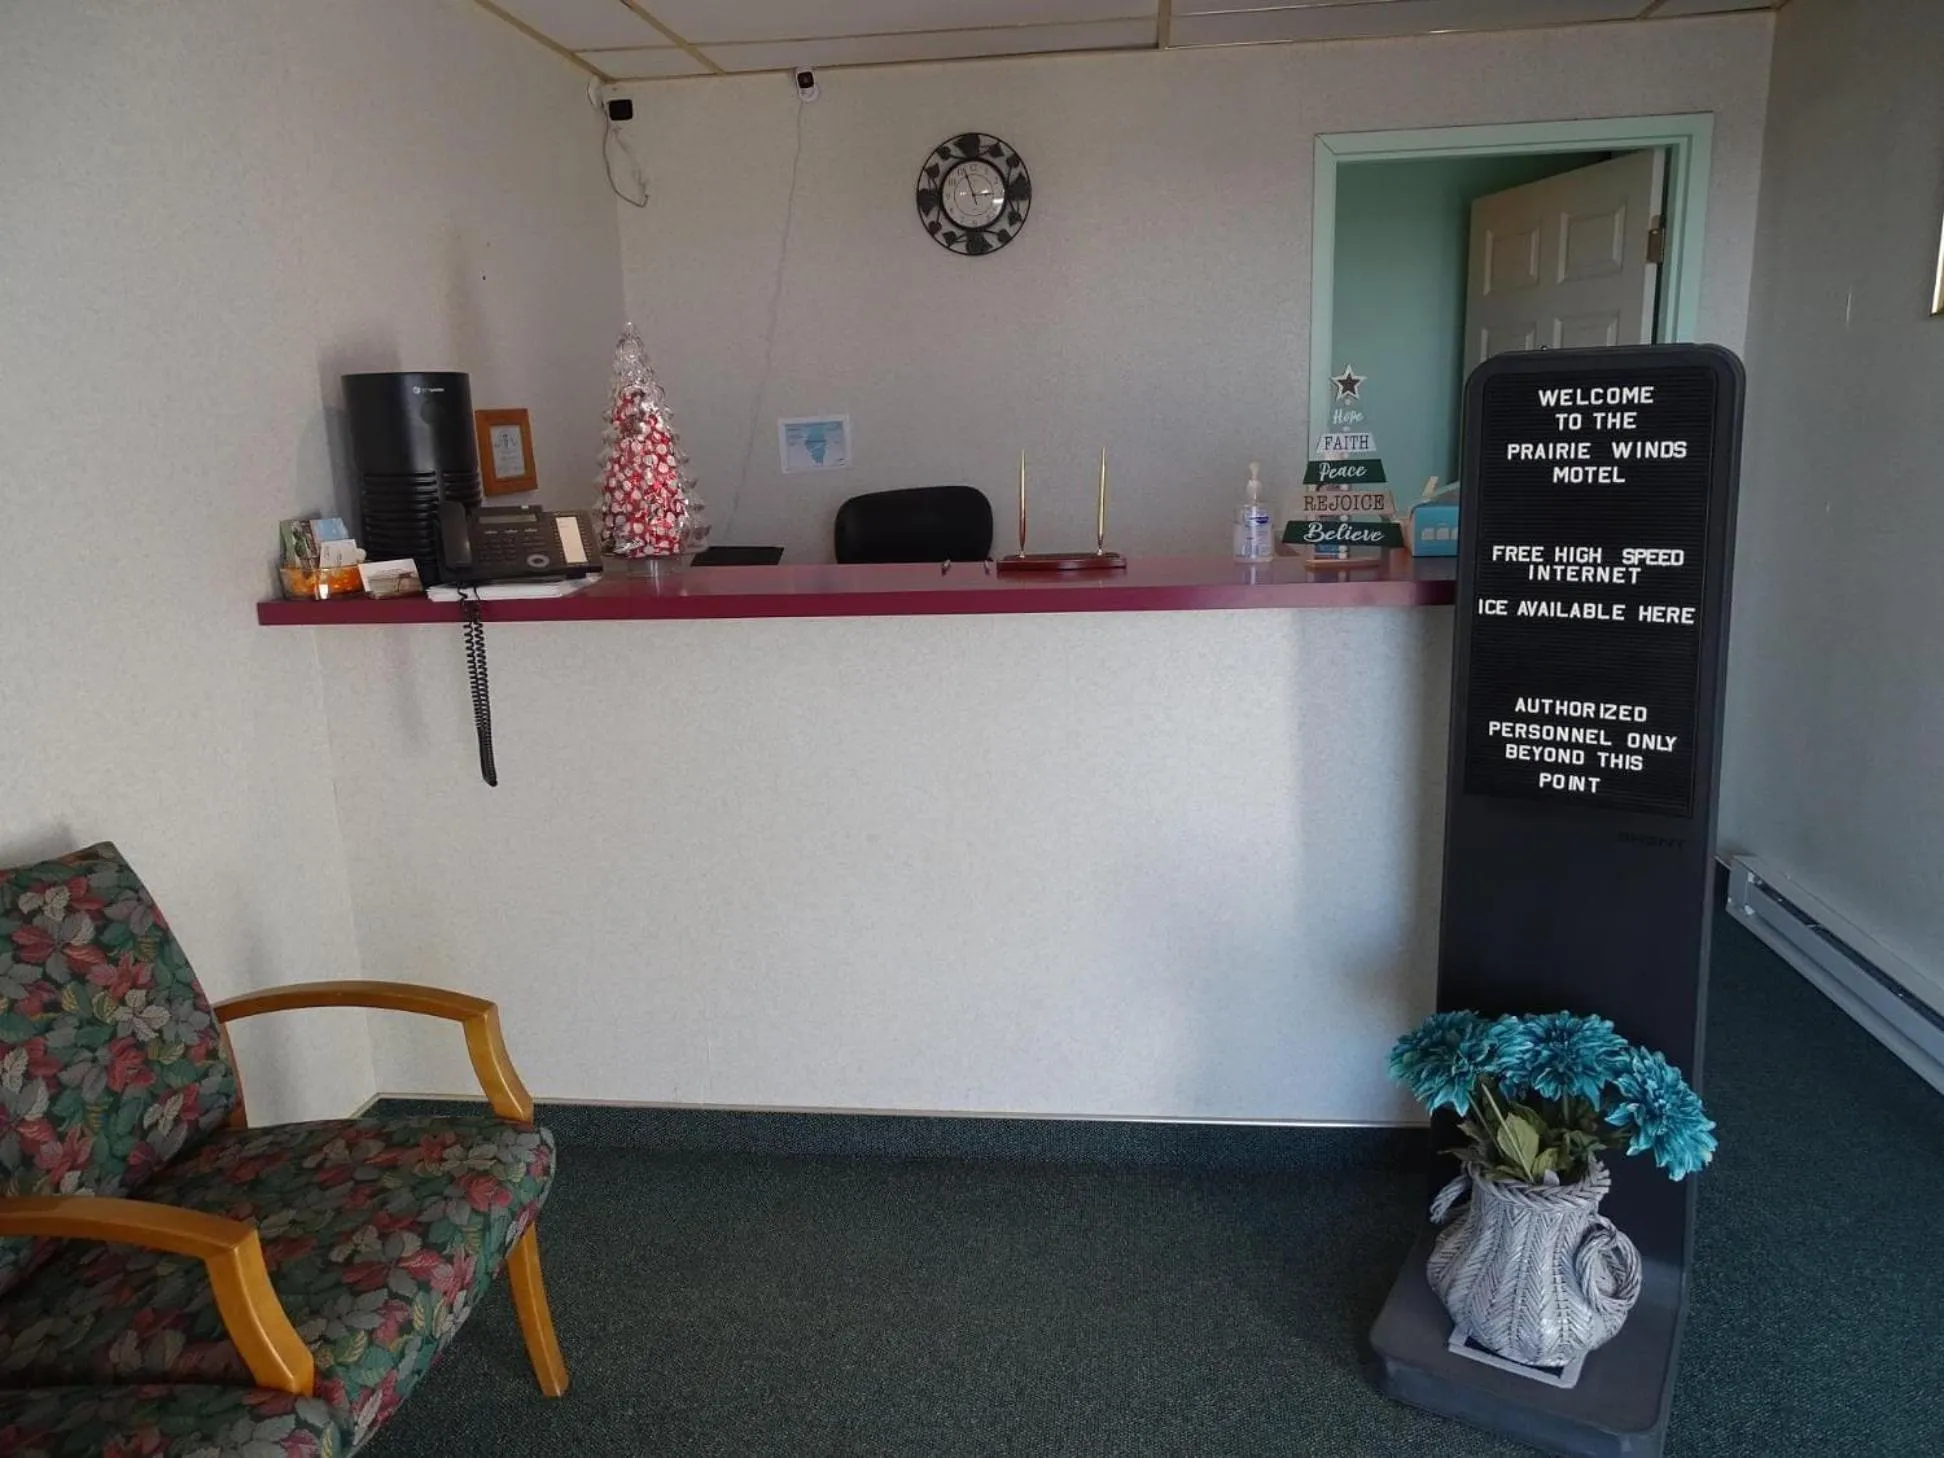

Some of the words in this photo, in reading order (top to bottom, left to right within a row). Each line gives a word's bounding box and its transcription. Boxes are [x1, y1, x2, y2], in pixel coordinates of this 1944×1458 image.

[1538, 386, 1655, 407] WELCOME
[1333, 408, 1364, 425] Hope
[1555, 412, 1582, 431] TO
[1592, 411, 1638, 430] THE
[1324, 435, 1369, 451] FAITH
[1507, 442, 1592, 461] PRAIRIE
[1611, 440, 1688, 459] WINDS
[1319, 461, 1368, 482] Peace
[1552, 465, 1626, 484] MOTEL
[1303, 493, 1385, 512] REJOICE
[1303, 521, 1385, 543] Believe
[1492, 545, 1545, 563] FREE
[1554, 546, 1603, 564] HIGH
[1621, 547, 1685, 567] SPEED
[1528, 564, 1642, 584] INTERNET
[1478, 598, 1509, 616] ICE
[1516, 600, 1626, 621] AVAILABLE
[1638, 605, 1696, 625] HERE
[1514, 697, 1648, 723] AUTHORIZED
[1488, 720, 1613, 747] PERSONNEL
[1626, 732, 1678, 753] ONLY
[1505, 743, 1585, 766] BEYOND
[1596, 751, 1644, 771] THIS
[1539, 772, 1601, 793] POINT
